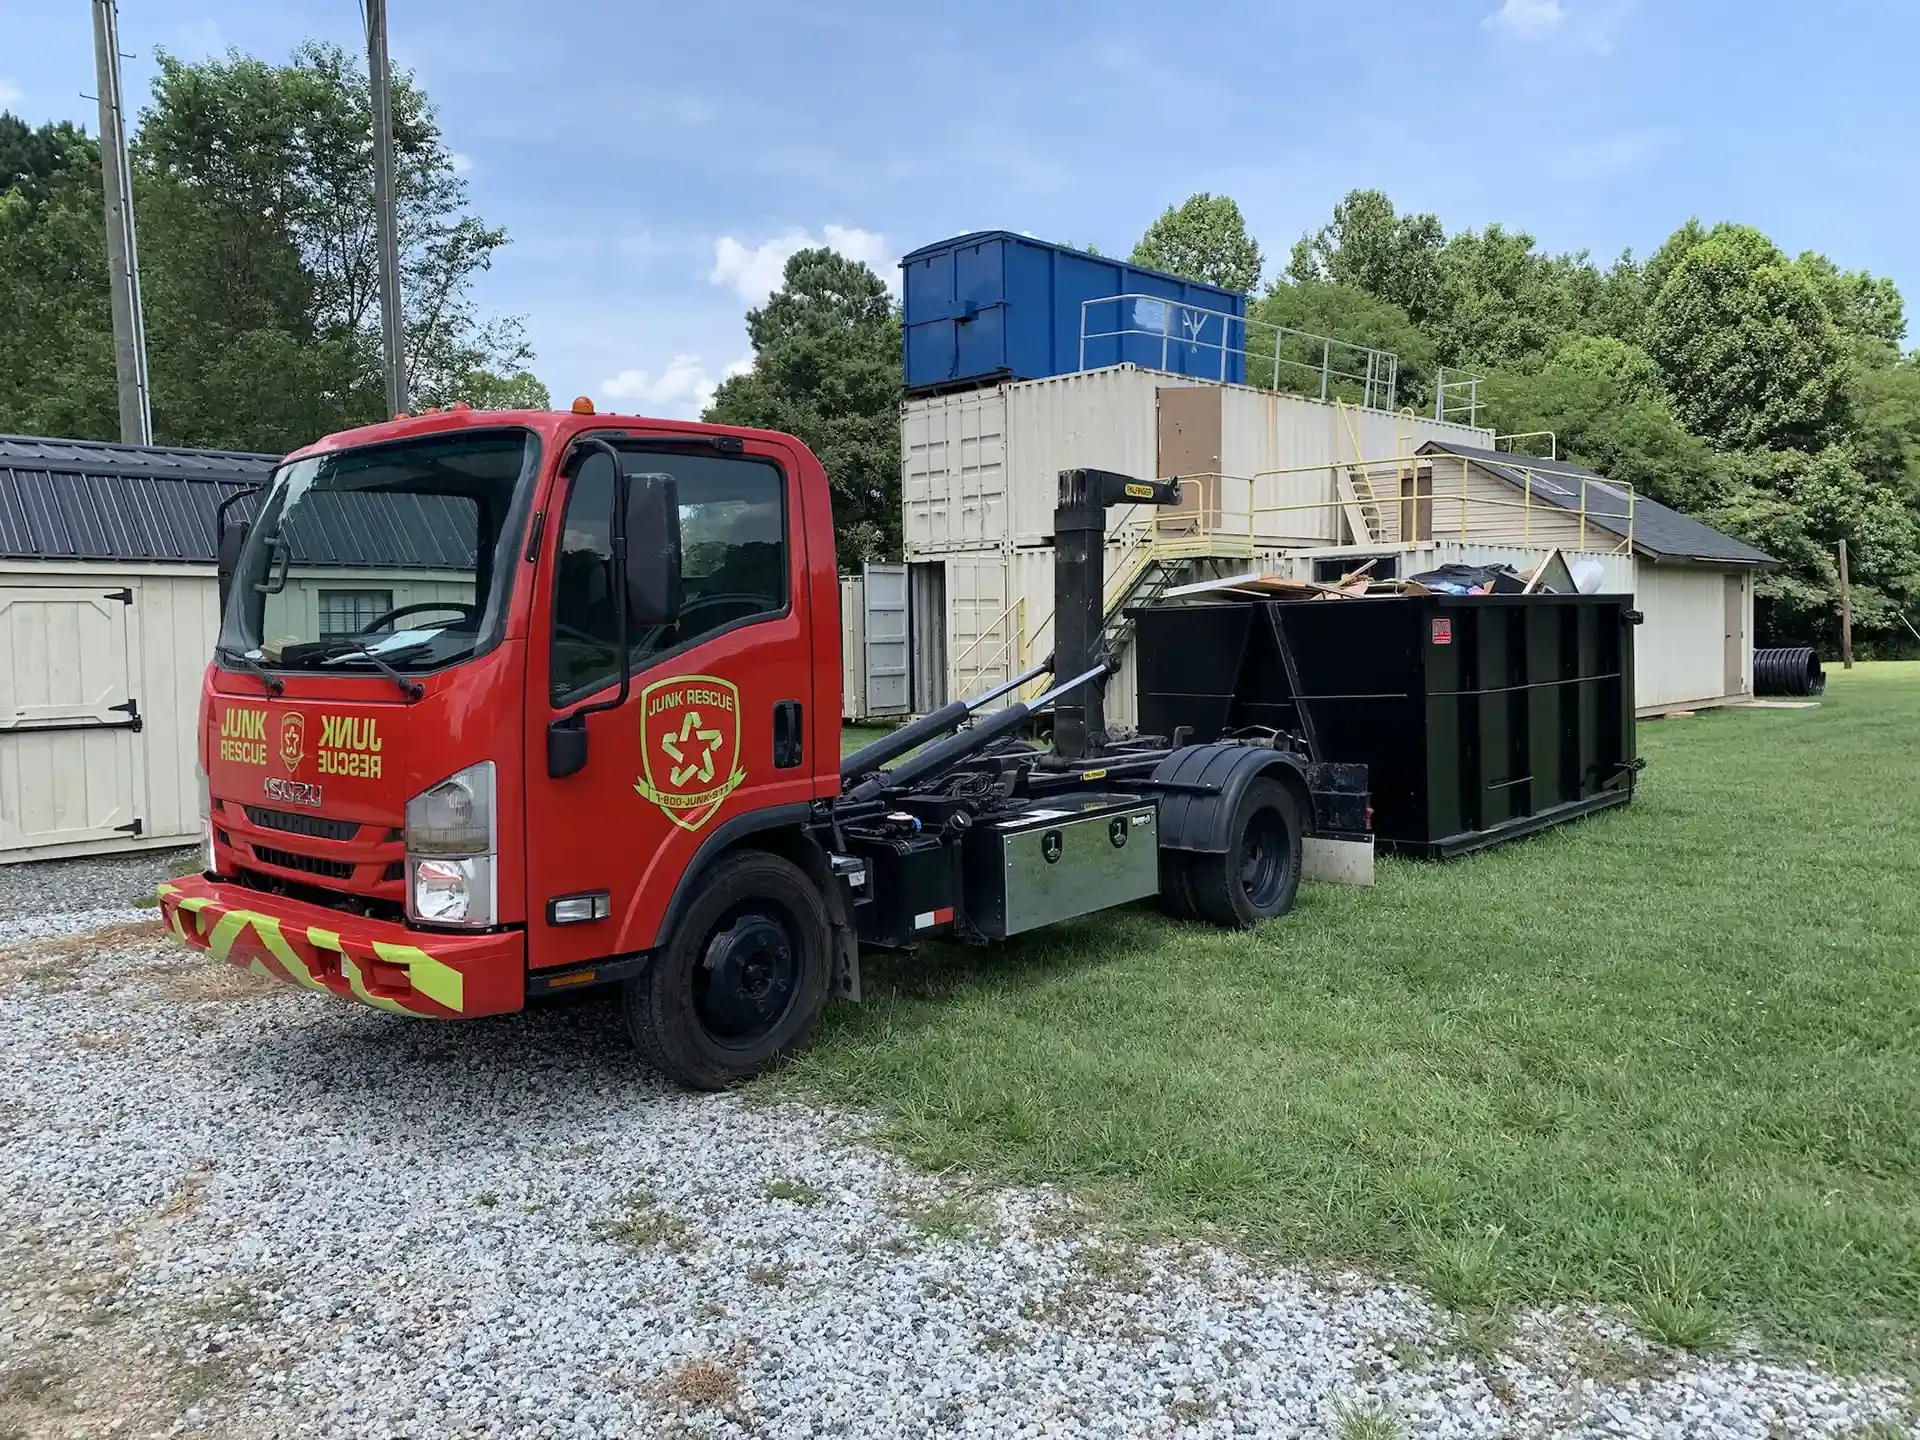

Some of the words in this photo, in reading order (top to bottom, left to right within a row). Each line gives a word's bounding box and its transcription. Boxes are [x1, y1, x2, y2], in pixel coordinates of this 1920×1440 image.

[1127, 485, 1152, 497] PALFINGER
[649, 691, 684, 716] JUNK
[686, 689, 733, 712] RESCUE
[221, 708, 268, 740] JUNK
[220, 740, 267, 766] RESCUE
[264, 777, 322, 807] ISUZU
[655, 784, 729, 807] 1-800-JUNK-911
